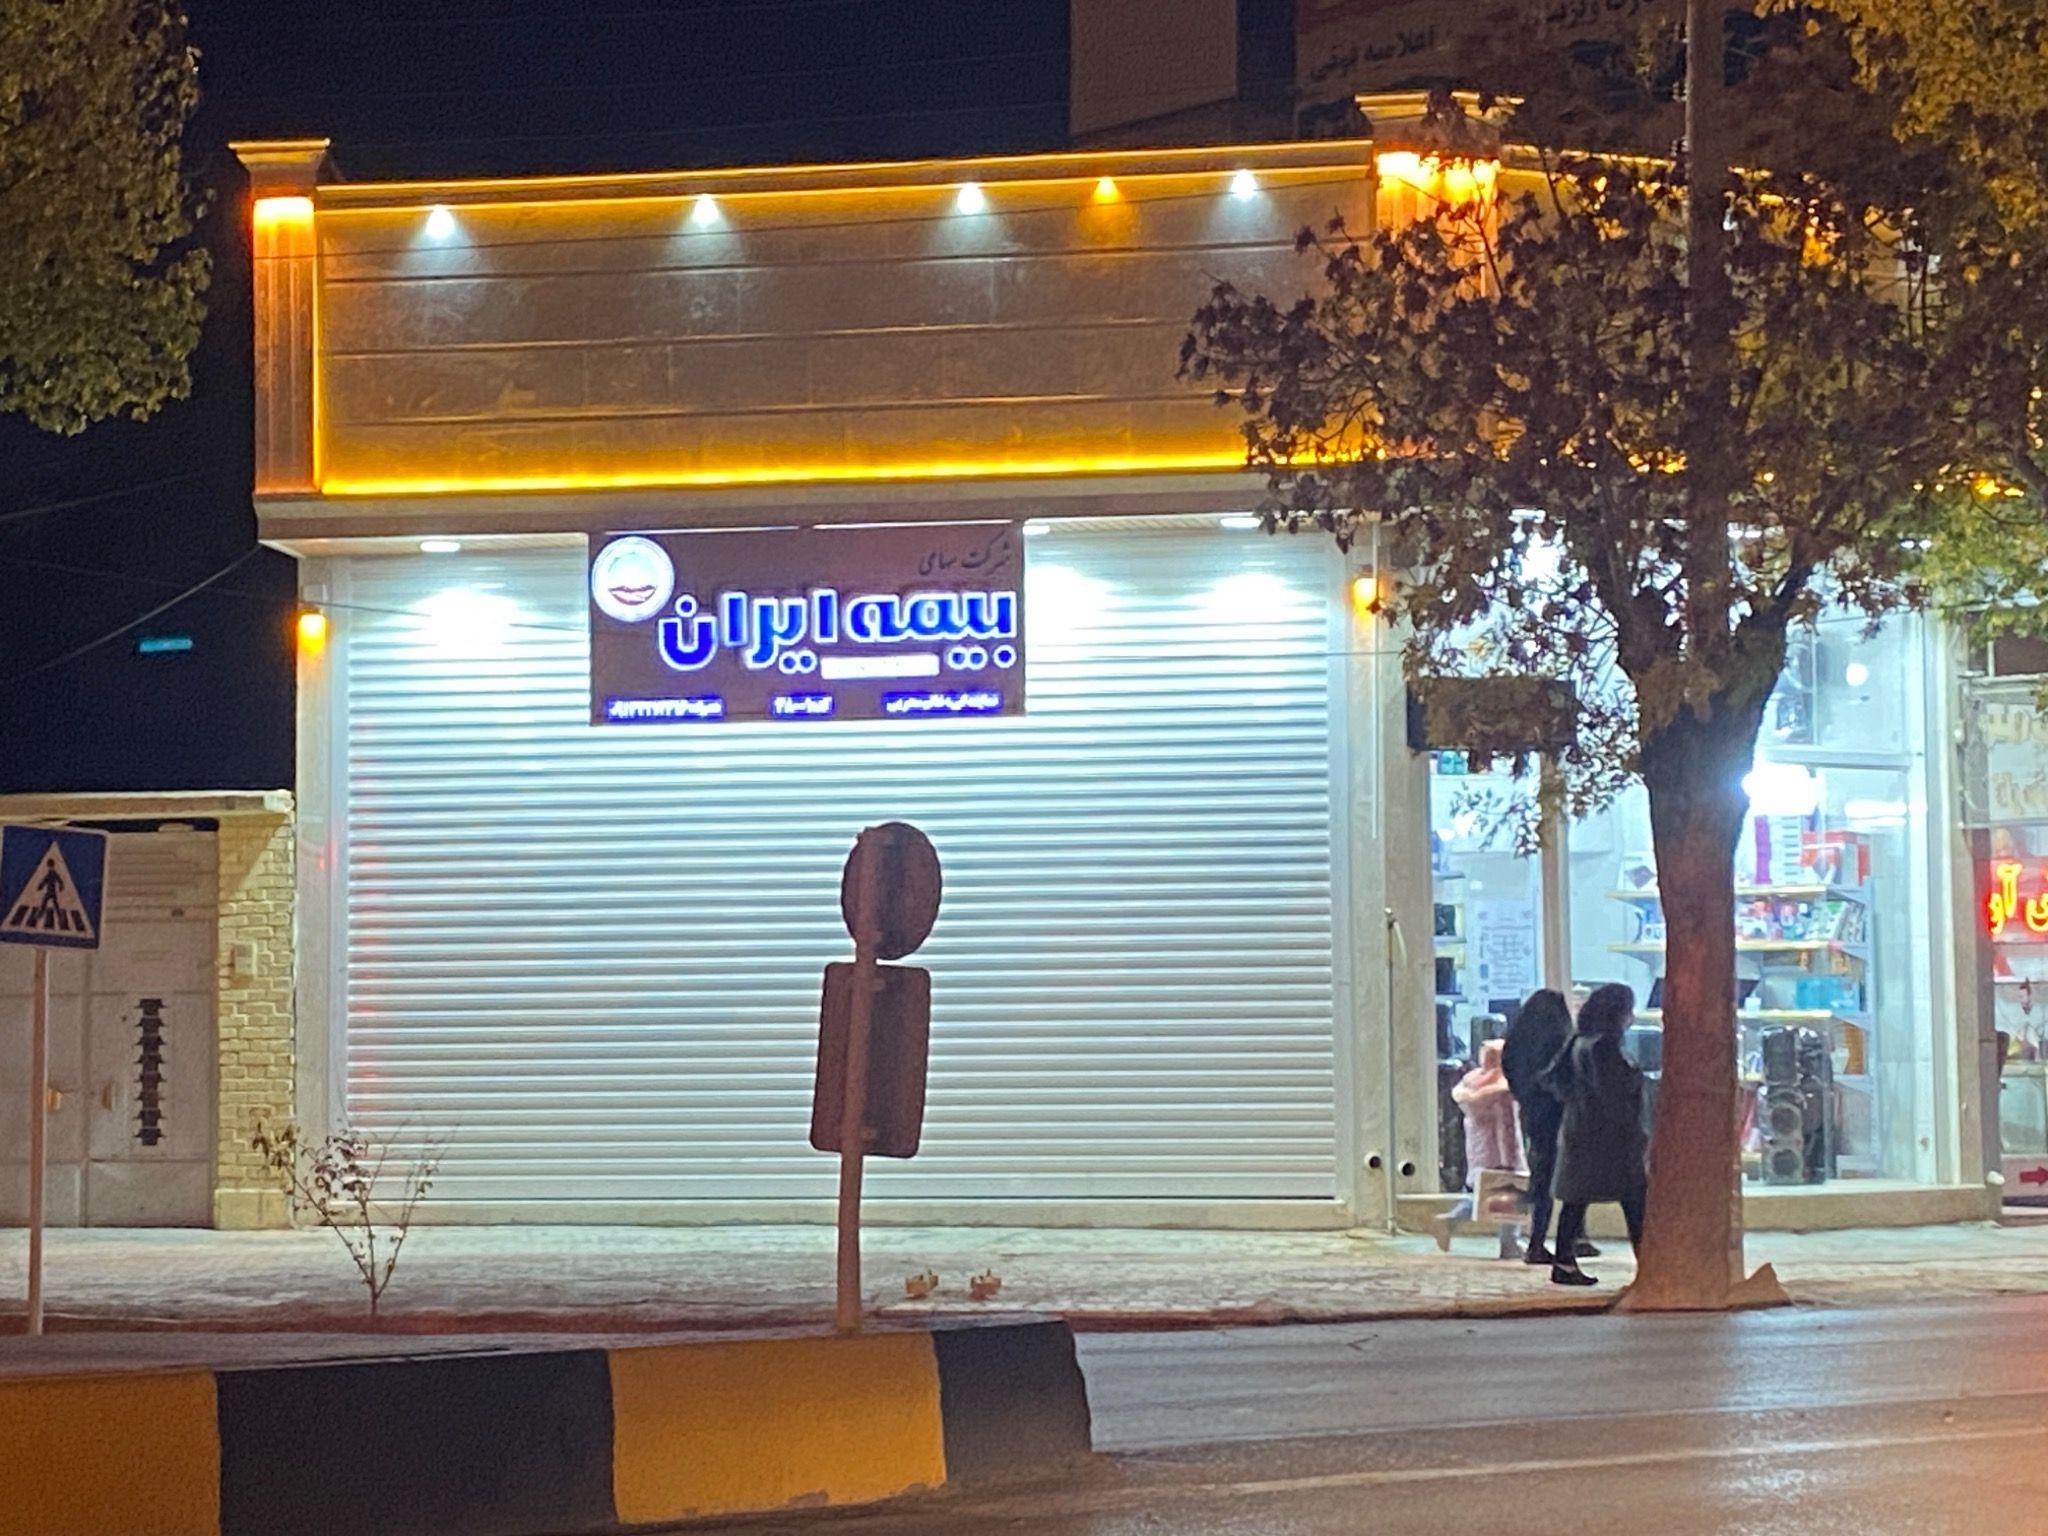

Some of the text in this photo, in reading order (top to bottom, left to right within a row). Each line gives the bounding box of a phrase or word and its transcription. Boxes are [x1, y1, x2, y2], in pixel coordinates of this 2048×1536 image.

[961, 528, 1011, 576] شرکت
[657, 588, 1018, 674] بیمه ایران
